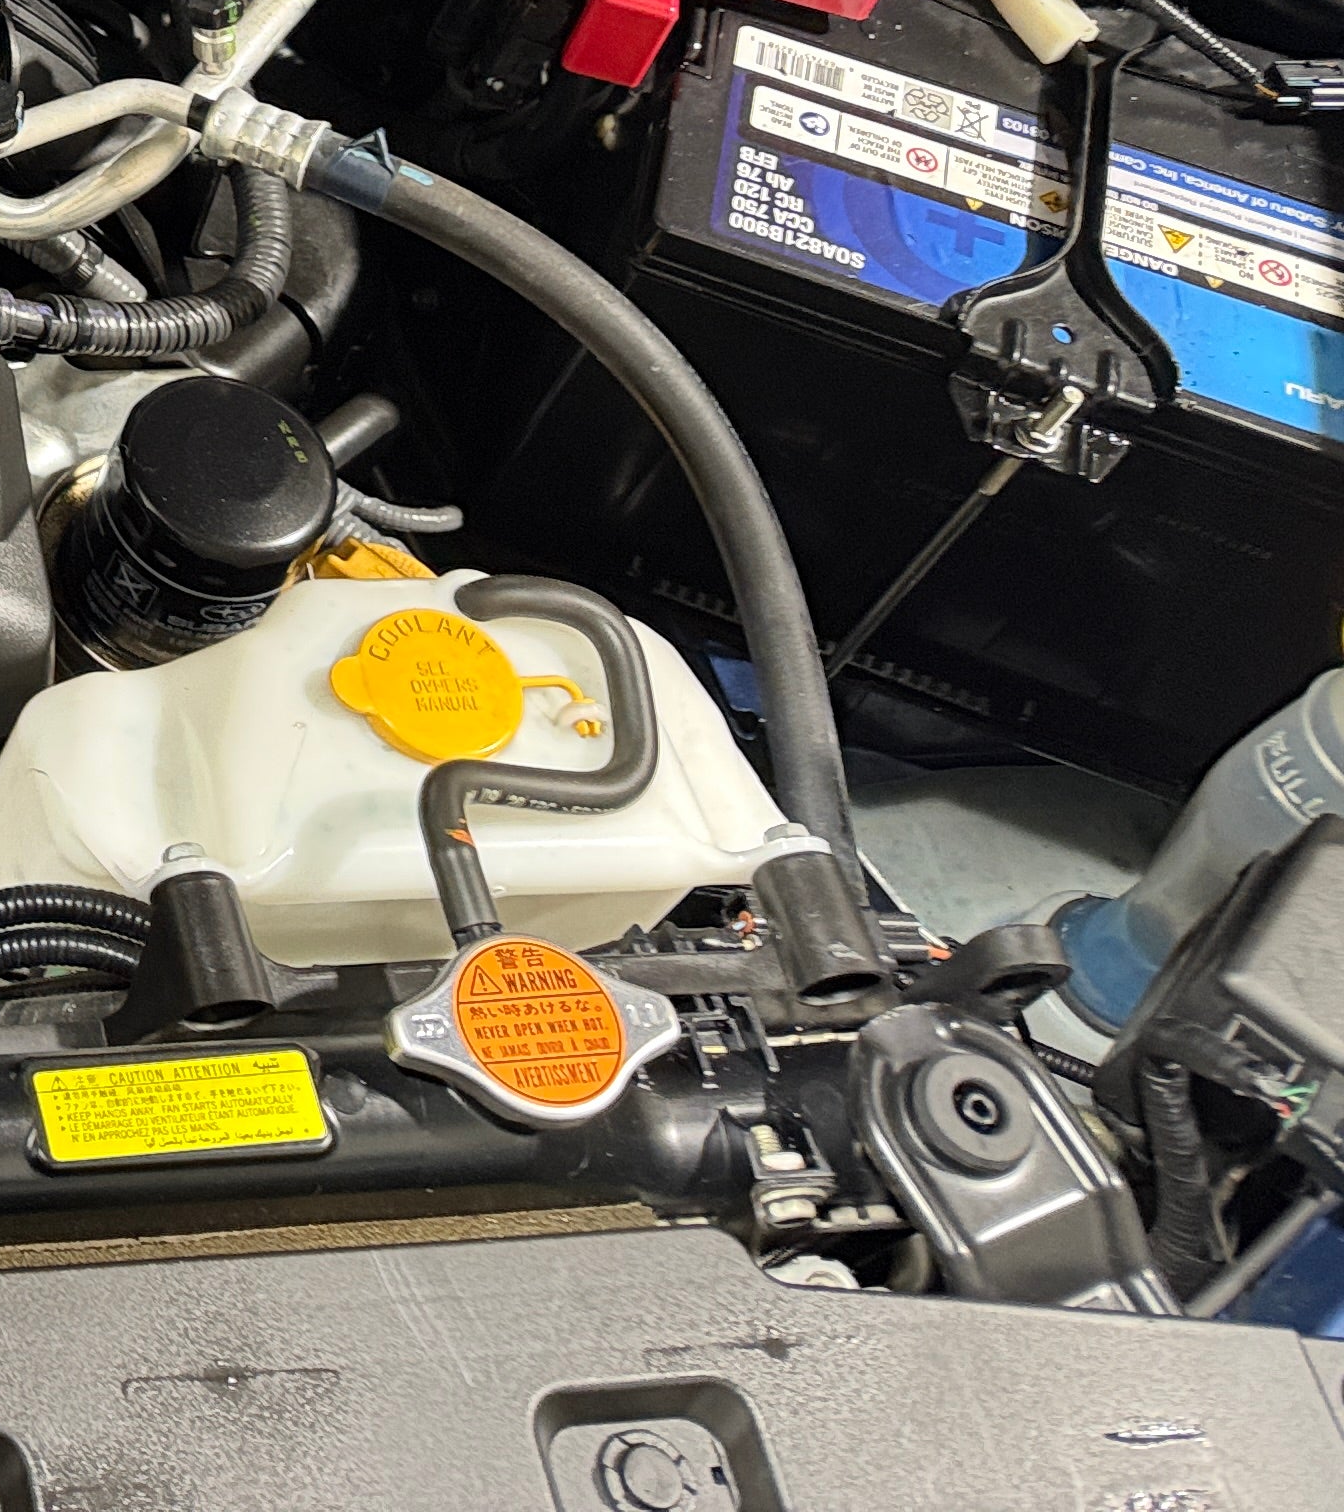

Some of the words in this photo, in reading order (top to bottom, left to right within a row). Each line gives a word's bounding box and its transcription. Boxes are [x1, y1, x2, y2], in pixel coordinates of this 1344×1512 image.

[856, 136, 884, 150] REACH
[858, 144, 876, 155] OUT
[886, 145, 901, 155] THE
[736, 144, 779, 171] EFB
[878, 149, 901, 163] KEEP
[733, 160, 765, 183] 76
[762, 170, 795, 192] Ah
[1146, 162, 1179, 181] Inc.
[731, 177, 773, 203] 120
[1178, 171, 1250, 204] America,
[729, 193, 772, 220] 750
[772, 190, 806, 213] RC
[1250, 195, 1268, 210] of
[768, 206, 816, 234] CCA
[1267, 200, 1327, 228] Subaru
[1099, 241, 1180, 276] DANGE
[369, 614, 496, 661] COOLANT
[494, 945, 544, 970] 警告
[501, 967, 577, 993] WARNING
[474, 1024, 510, 1039] NEVER
[514, 1021, 543, 1036] OPEN
[544, 1018, 577, 1034] WHEN
[582, 1016, 608, 1031] HOT.
[108, 1068, 163, 1085] CAUTION
[173, 1062, 241, 1079] ATTENTION
[67, 1111, 91, 1121] KEEP
[94, 1108, 127, 1119] HANDS
[161, 1103, 179, 1113] FAN
[182, 1100, 217, 1112] STARTS
[69, 1122, 79, 1132] LE
[136, 1116, 149, 1126] DU
[82, 1132, 95, 1142] EN
[98, 1127, 149, 1140] APPROCHEZ
[152, 1126, 169, 1135] PAS
[171, 1124, 187, 1134] LES
